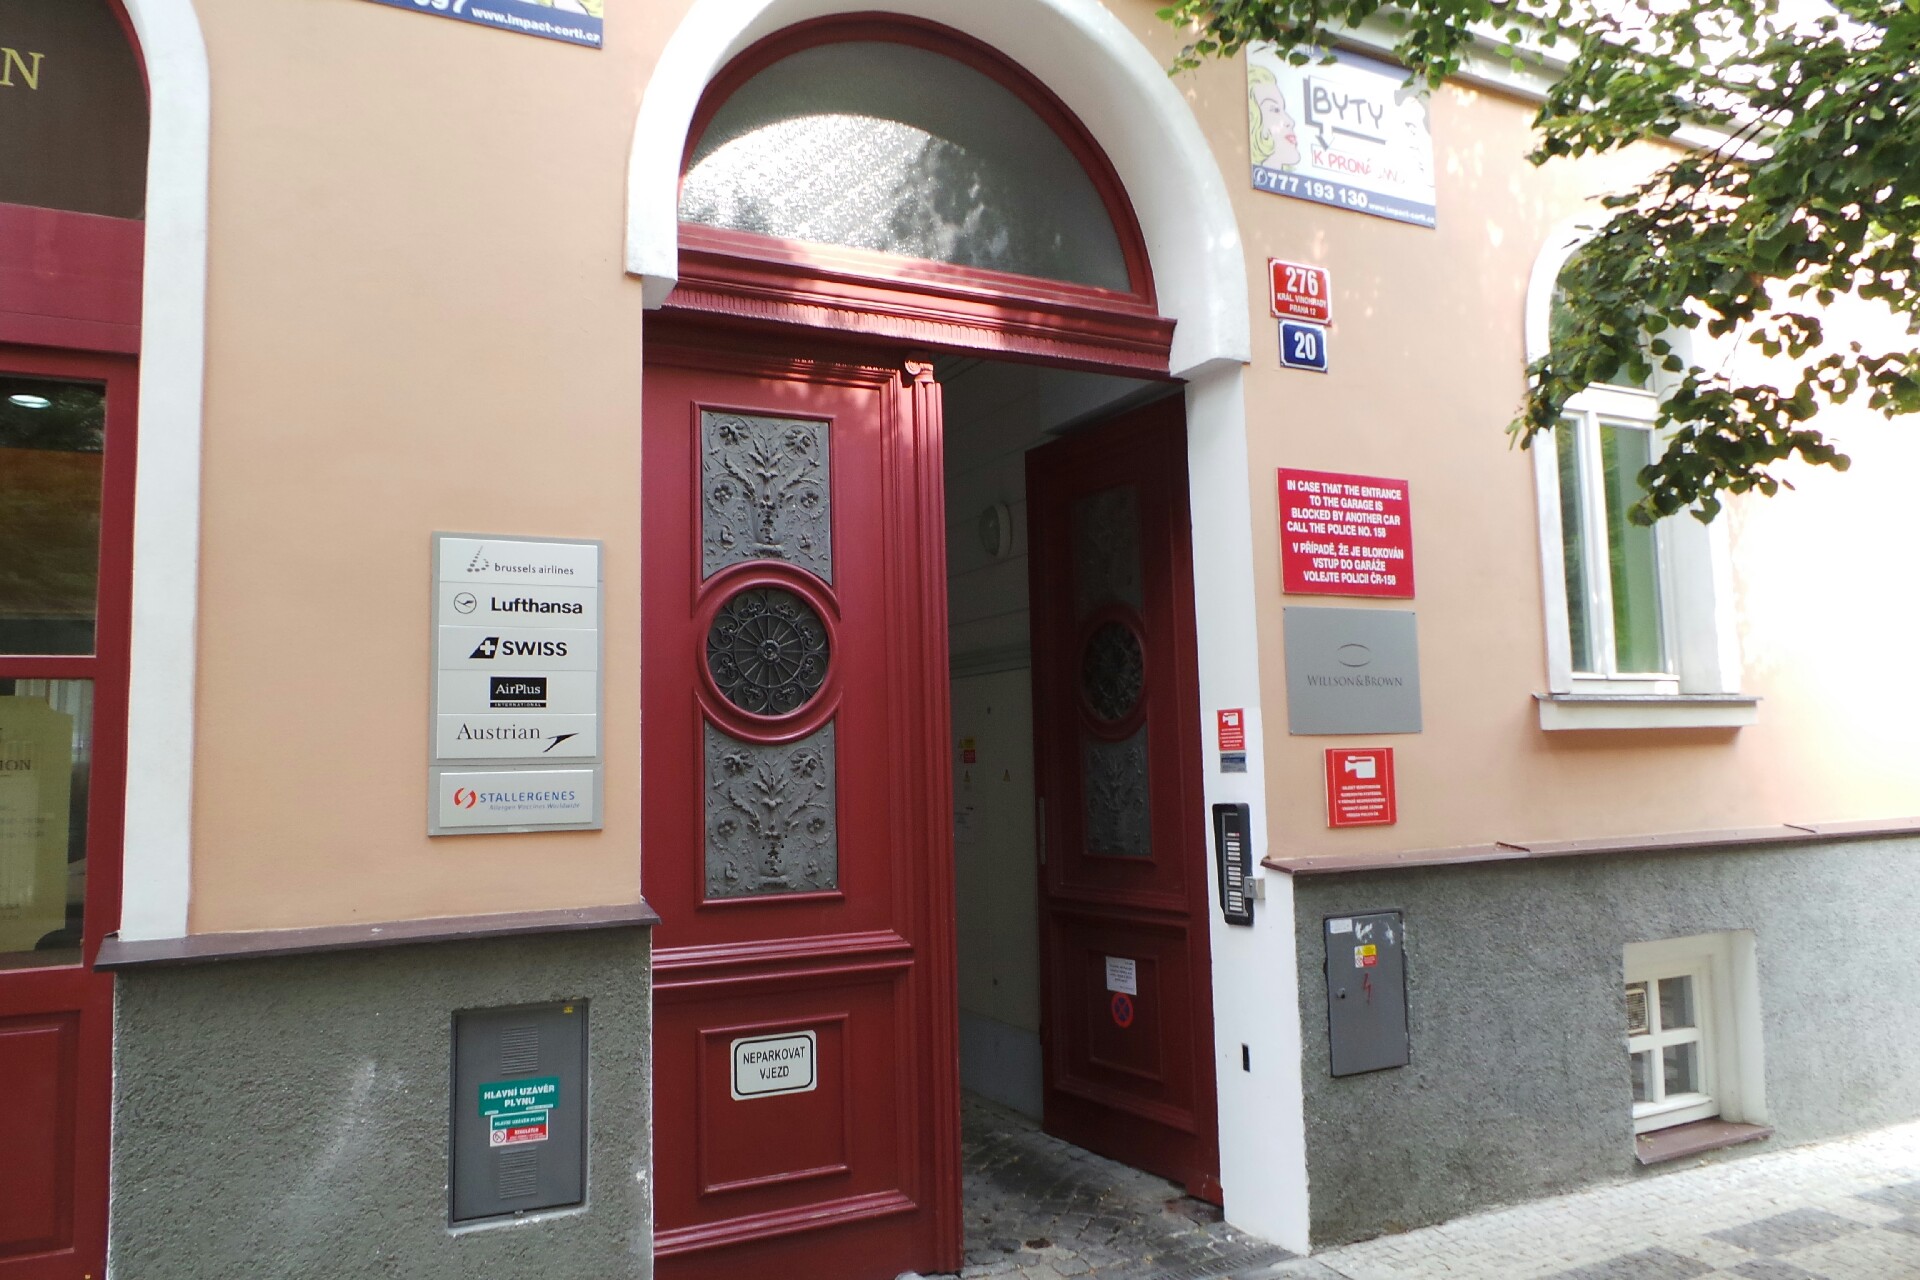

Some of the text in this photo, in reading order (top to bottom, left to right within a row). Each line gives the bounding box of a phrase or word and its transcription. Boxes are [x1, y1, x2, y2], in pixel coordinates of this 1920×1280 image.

[471, 7, 600, 42] www.impact-corti.cz
[1313, 86, 1384, 129] BYTY
[1313, 149, 1323, 165] K
[1267, 172, 1299, 193] 777
[1304, 180, 1335, 201] 193
[1338, 188, 1368, 208] 130
[1285, 266, 1319, 296] 276
[1289, 304, 1317, 316] PRAHA 12
[1294, 331, 1317, 360] 20
[1286, 480, 1402, 500] IN CASE THAT THE ENTRANCE
[1309, 494, 1384, 511] TO THE GARAGE IS
[1291, 507, 1400, 526] BLOCKED BY ANOTHER CAR
[1286, 521, 1386, 538] CALL THE POLICE NO. 158
[1292, 542, 1299, 553] V
[1338, 542, 1349, 556] ŽE
[1350, 546, 1361, 557] JE
[1362, 546, 1404, 559] BLOKOVÁN
[494, 563, 574, 575] brussels airlines
[1313, 558, 1386, 572] VSTUP DO GARÁŽE
[1303, 570, 1340, 582] VOLEJTE
[1341, 572, 1369, 584] POLICII
[491, 597, 583, 614] Lufthansa
[502, 640, 568, 656] SWISS
[495, 683, 541, 695] AirPlus
[456, 722, 541, 740] Austrian
[480, 790, 576, 804] STALLERGENES
[743, 1046, 806, 1064] NEPARKOVAT
[760, 1065, 790, 1080] VJEZD
[484, 1084, 554, 1100] HLAVNÍ UZÁVĚR
[504, 1096, 536, 1108] PLYNU
